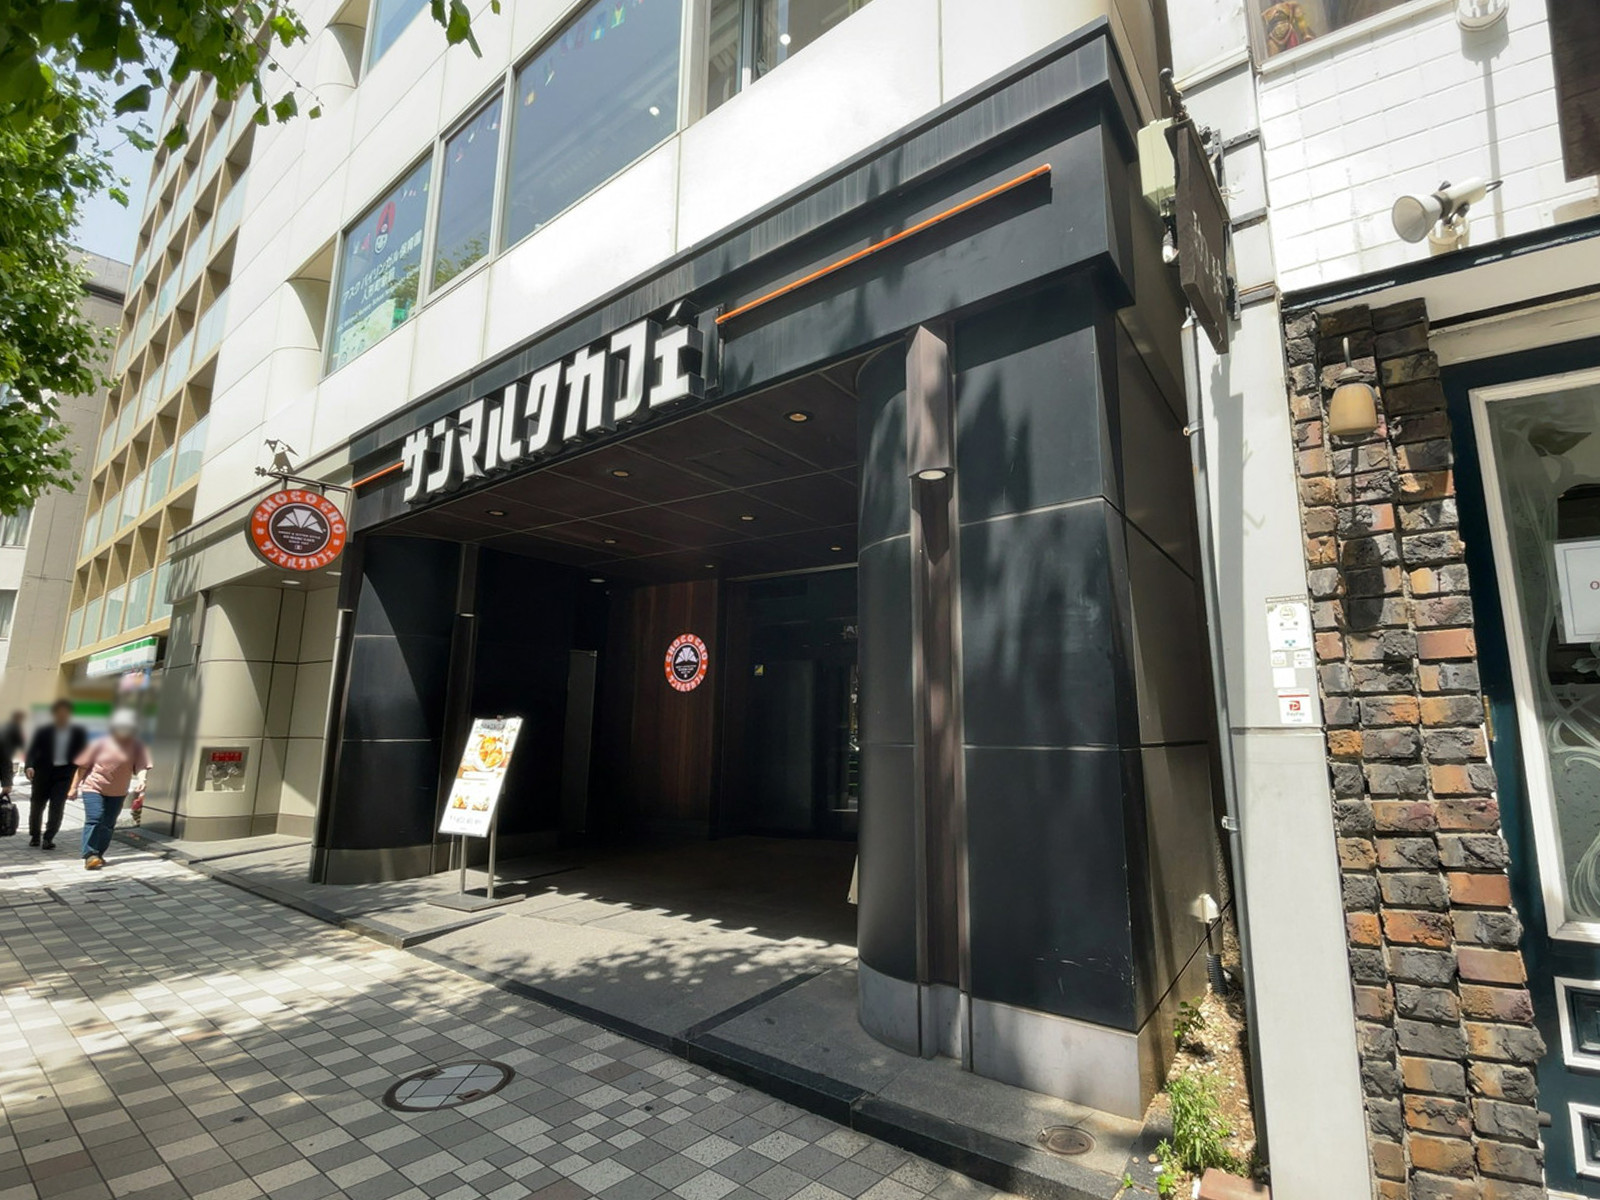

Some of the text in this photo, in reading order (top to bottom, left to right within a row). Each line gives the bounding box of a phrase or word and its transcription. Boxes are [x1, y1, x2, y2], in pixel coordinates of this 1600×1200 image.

[401, 300, 689, 503] サンマルクカフェ
[255, 491, 344, 534] CHOCOCRO
